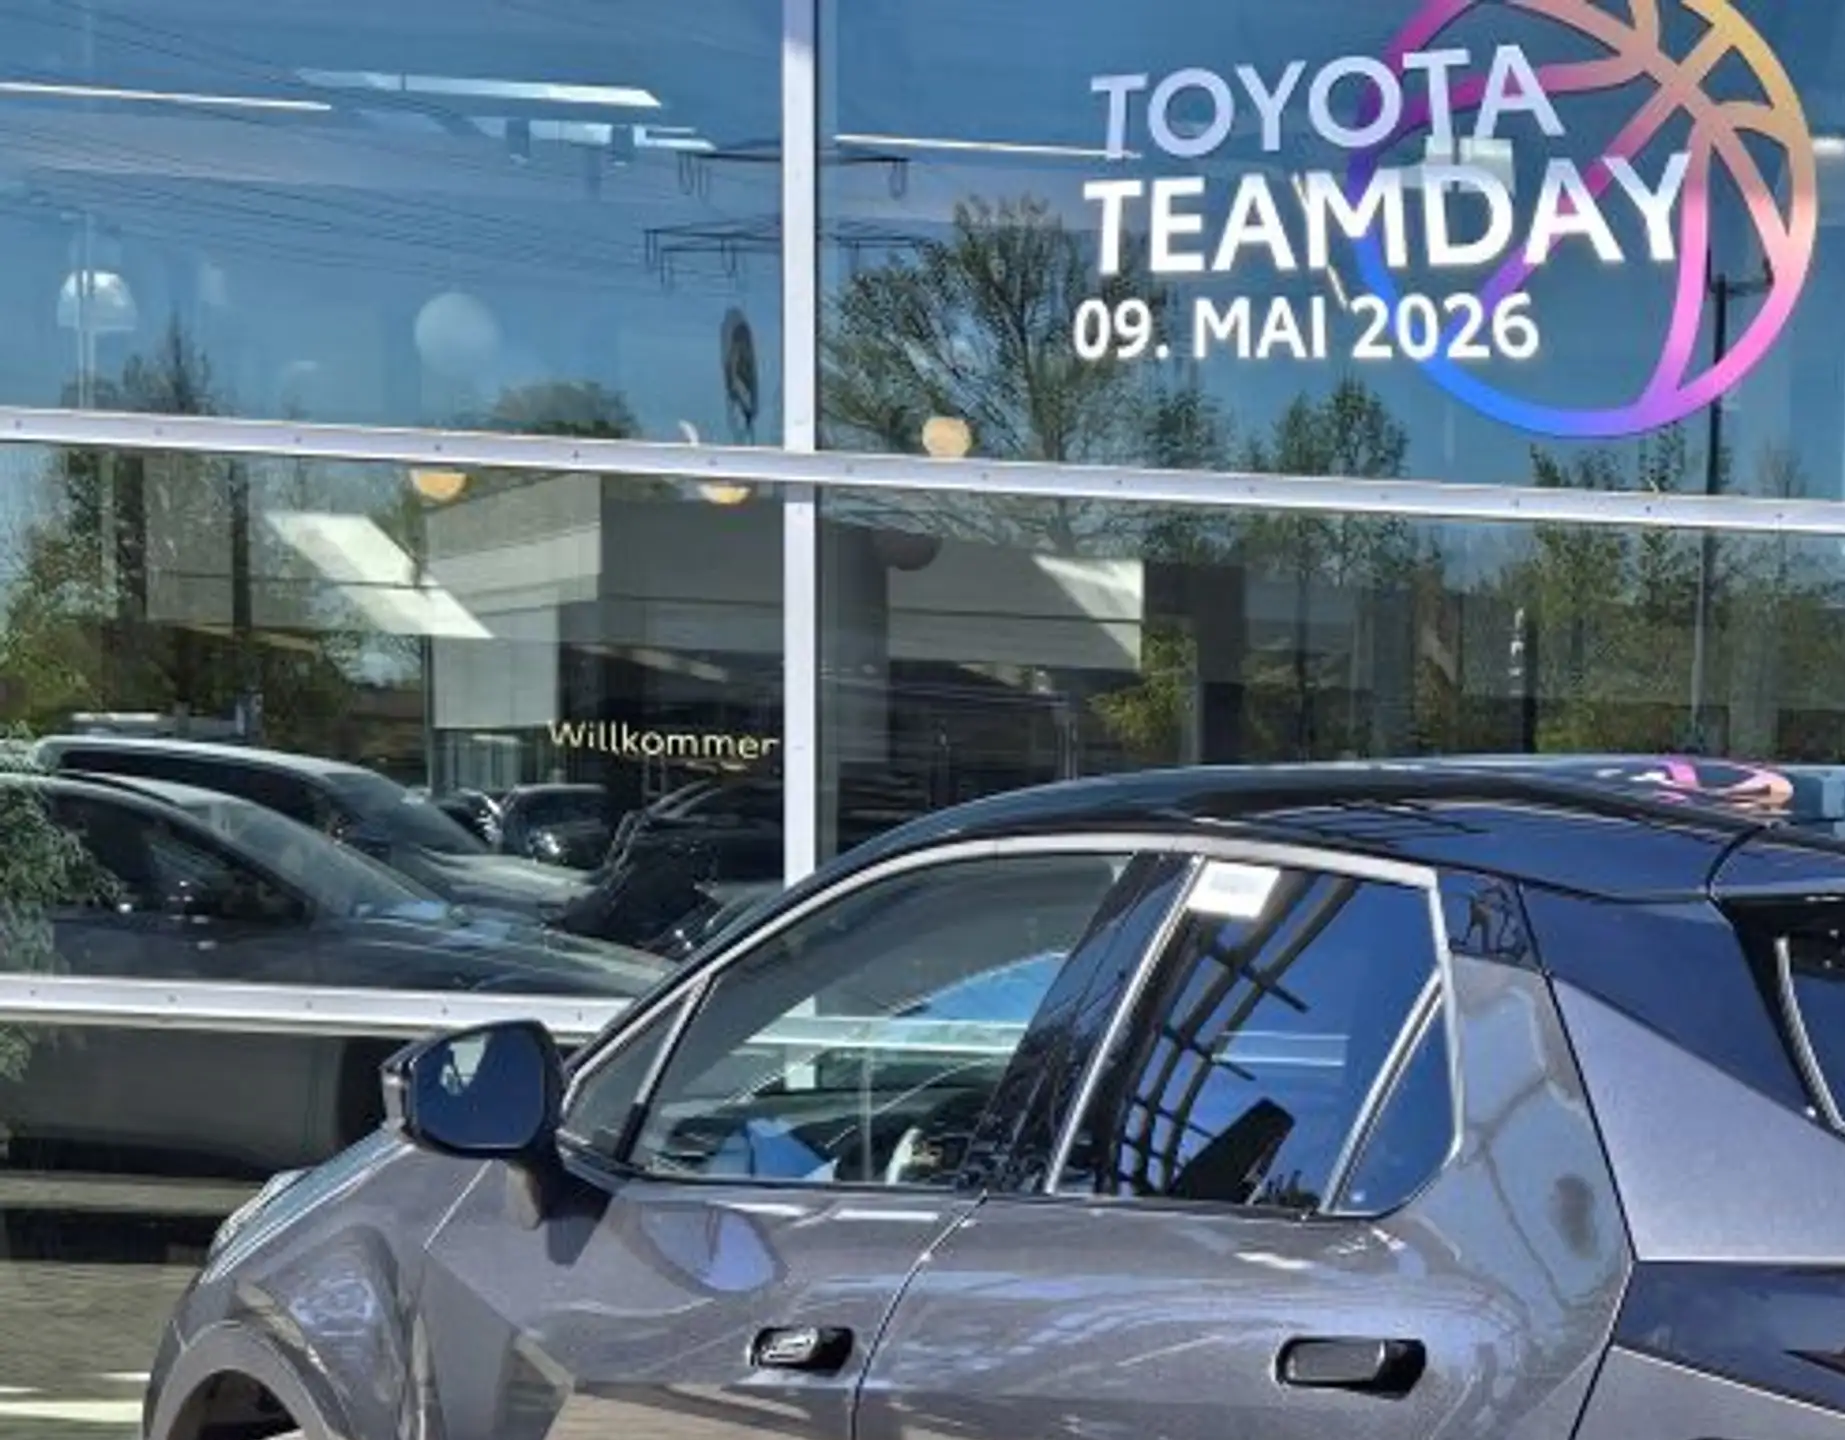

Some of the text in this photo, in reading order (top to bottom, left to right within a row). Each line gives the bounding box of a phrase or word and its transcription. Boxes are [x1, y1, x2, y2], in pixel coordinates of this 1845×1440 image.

[1091, 44, 1565, 160] TOYOTA
[1083, 151, 1693, 275] TEAMDAY
[1073, 292, 1540, 361] 09. MAI 2026
